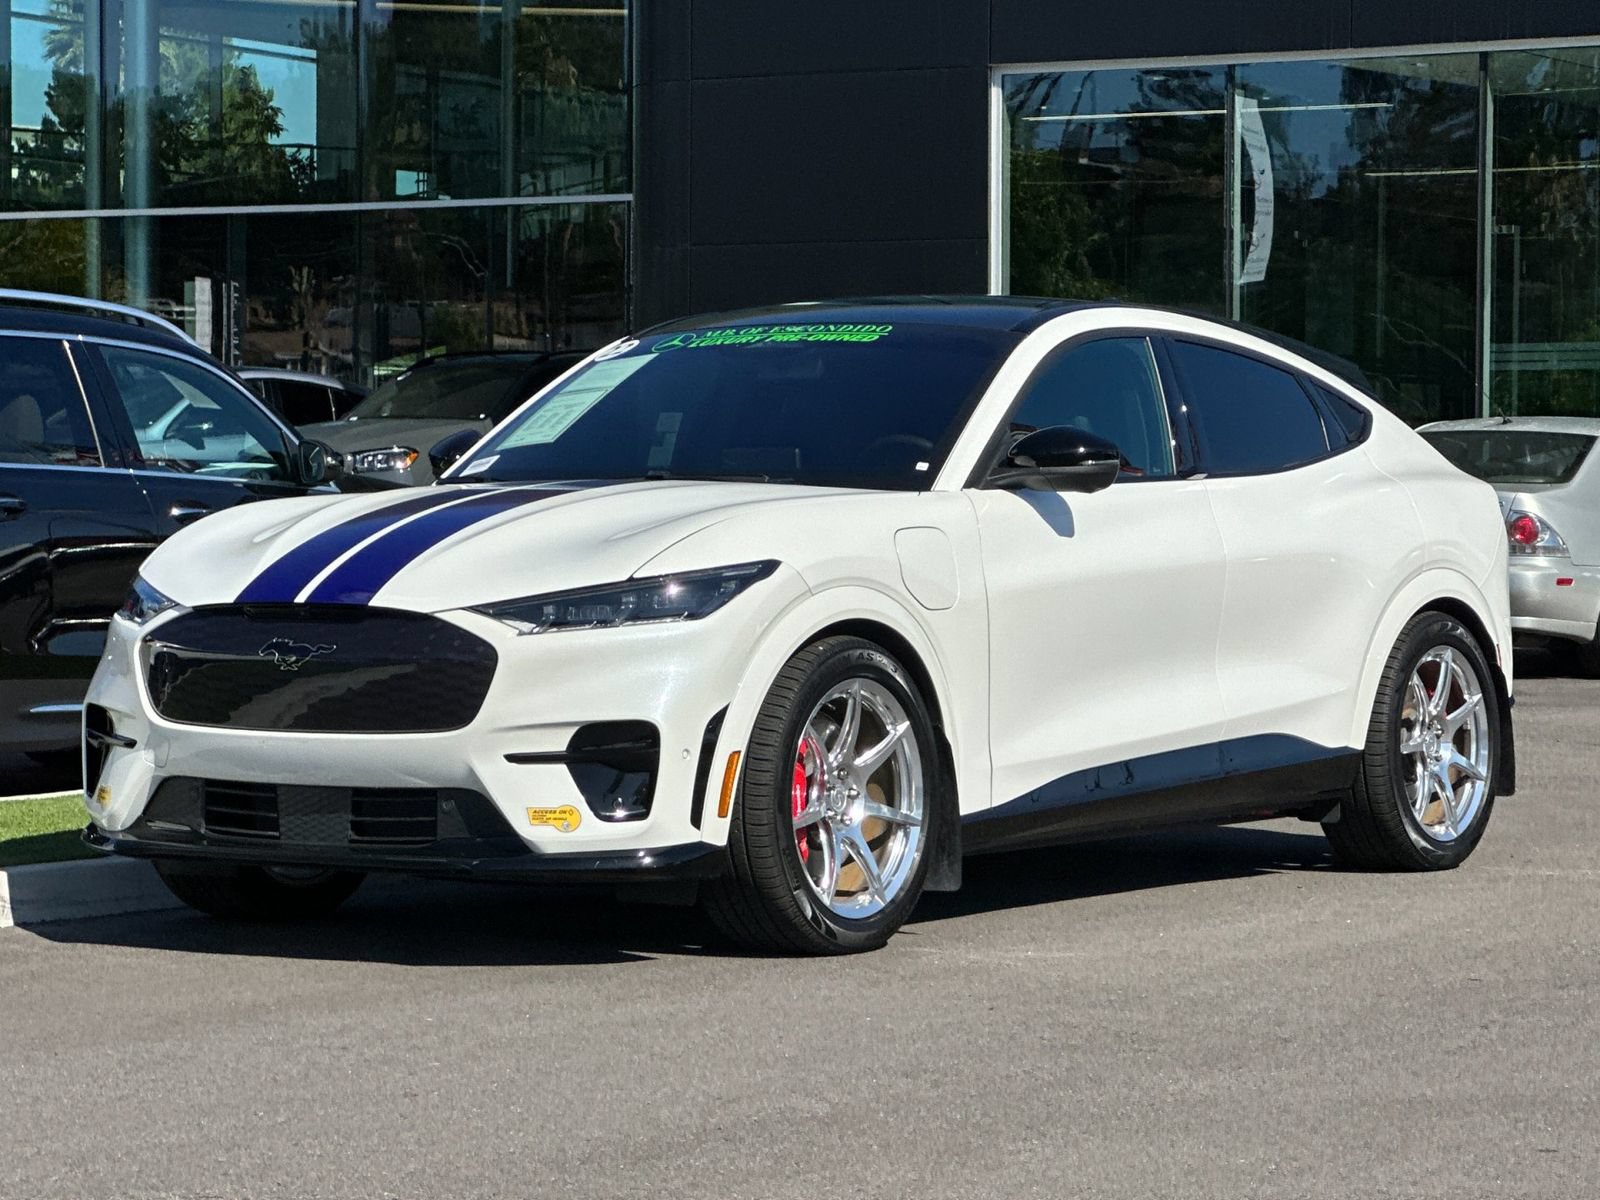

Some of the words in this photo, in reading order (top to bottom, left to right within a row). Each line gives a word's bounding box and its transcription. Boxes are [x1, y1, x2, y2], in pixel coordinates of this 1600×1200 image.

[769, 324, 894, 333] ESCONDIDO
[688, 334, 767, 348] LUXURY
[765, 333, 880, 342] PRE-OWNED
